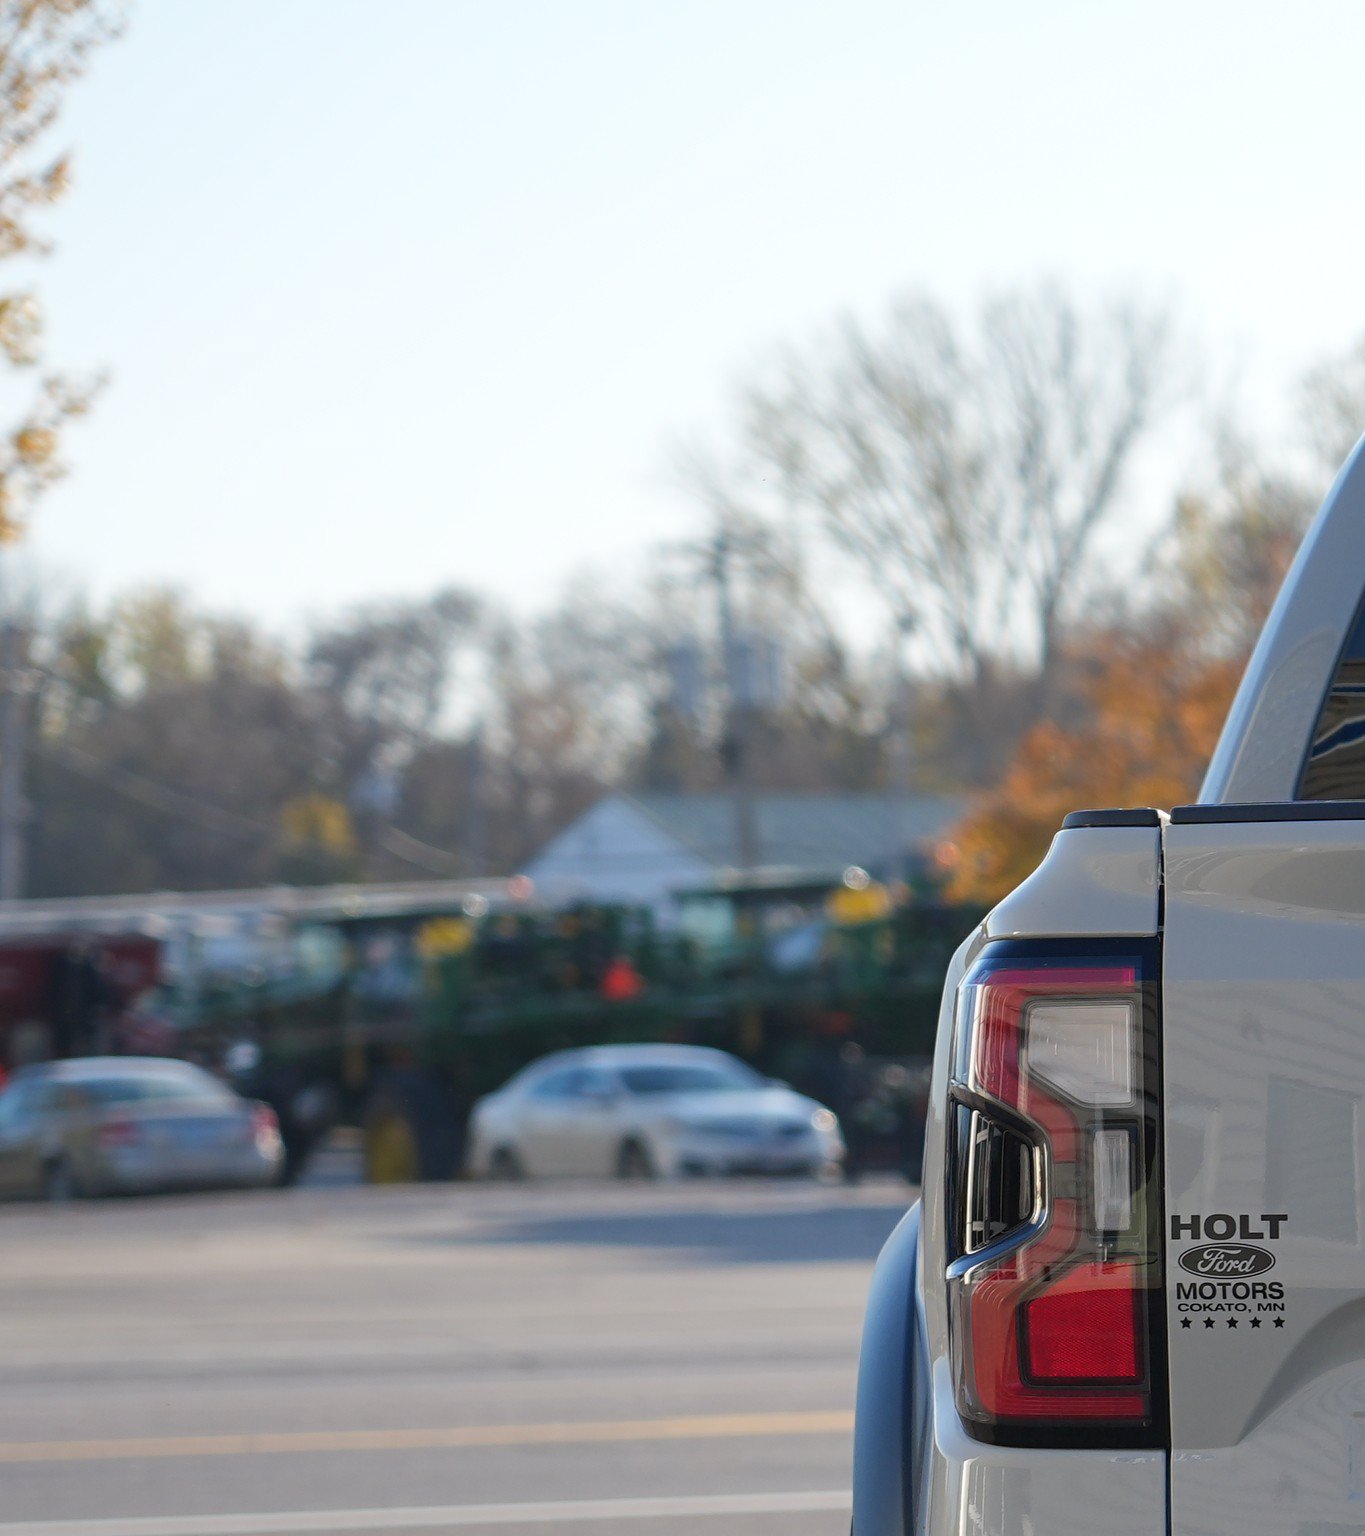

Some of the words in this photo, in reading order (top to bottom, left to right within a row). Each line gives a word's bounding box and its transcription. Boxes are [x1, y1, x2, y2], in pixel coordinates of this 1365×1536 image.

[1170, 1213, 1289, 1241] HOLT
[1197, 1247, 1257, 1273] Ford
[1176, 1281, 1285, 1301] MOTORS
[1177, 1302, 1252, 1314] COKATO,
[1257, 1302, 1285, 1312] MN
